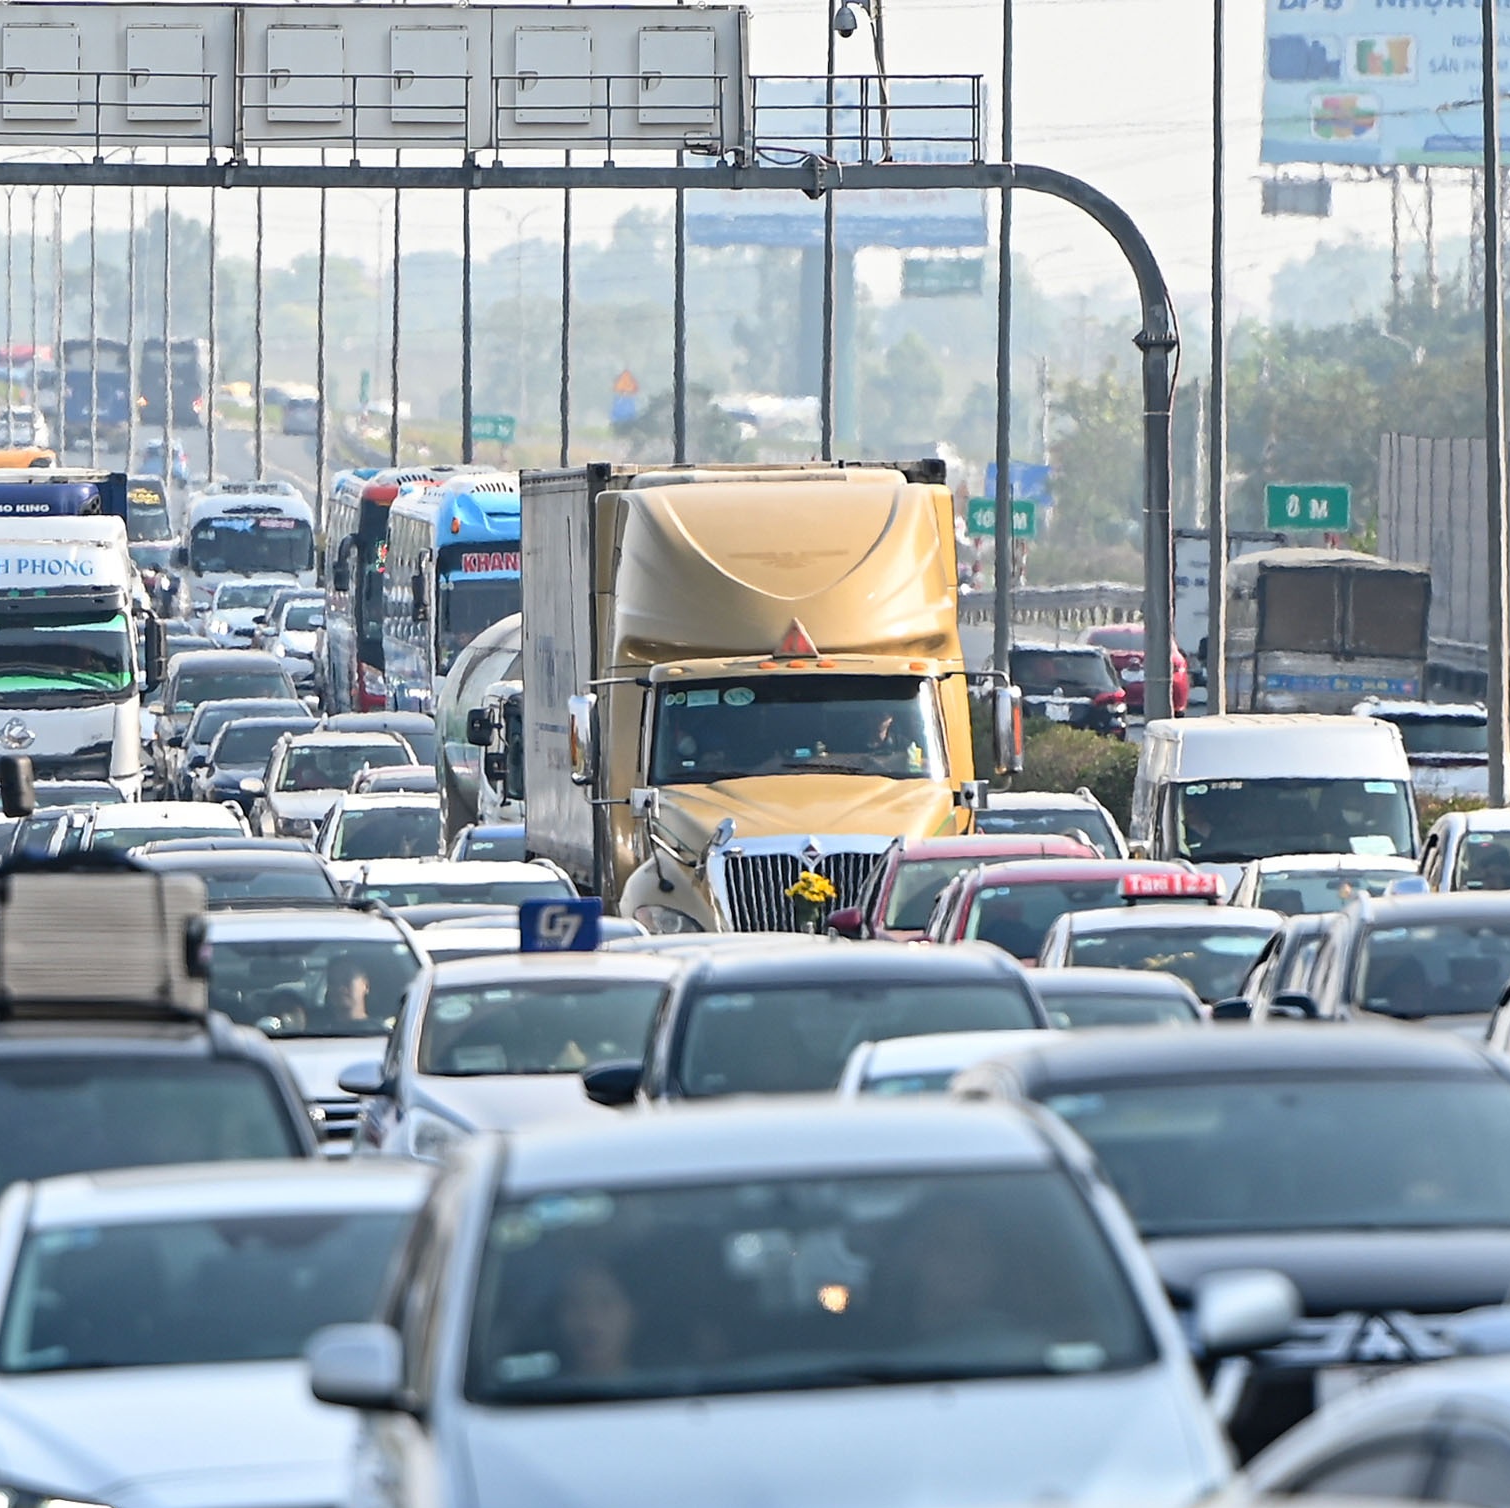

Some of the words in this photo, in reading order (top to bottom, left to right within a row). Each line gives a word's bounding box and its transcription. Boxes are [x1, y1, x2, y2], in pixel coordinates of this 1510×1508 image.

[16, 504, 50, 512] KING
[18, 558, 94, 577] PHONG
[1128, 873, 1169, 893] Taxi
[537, 904, 583, 949] G7
